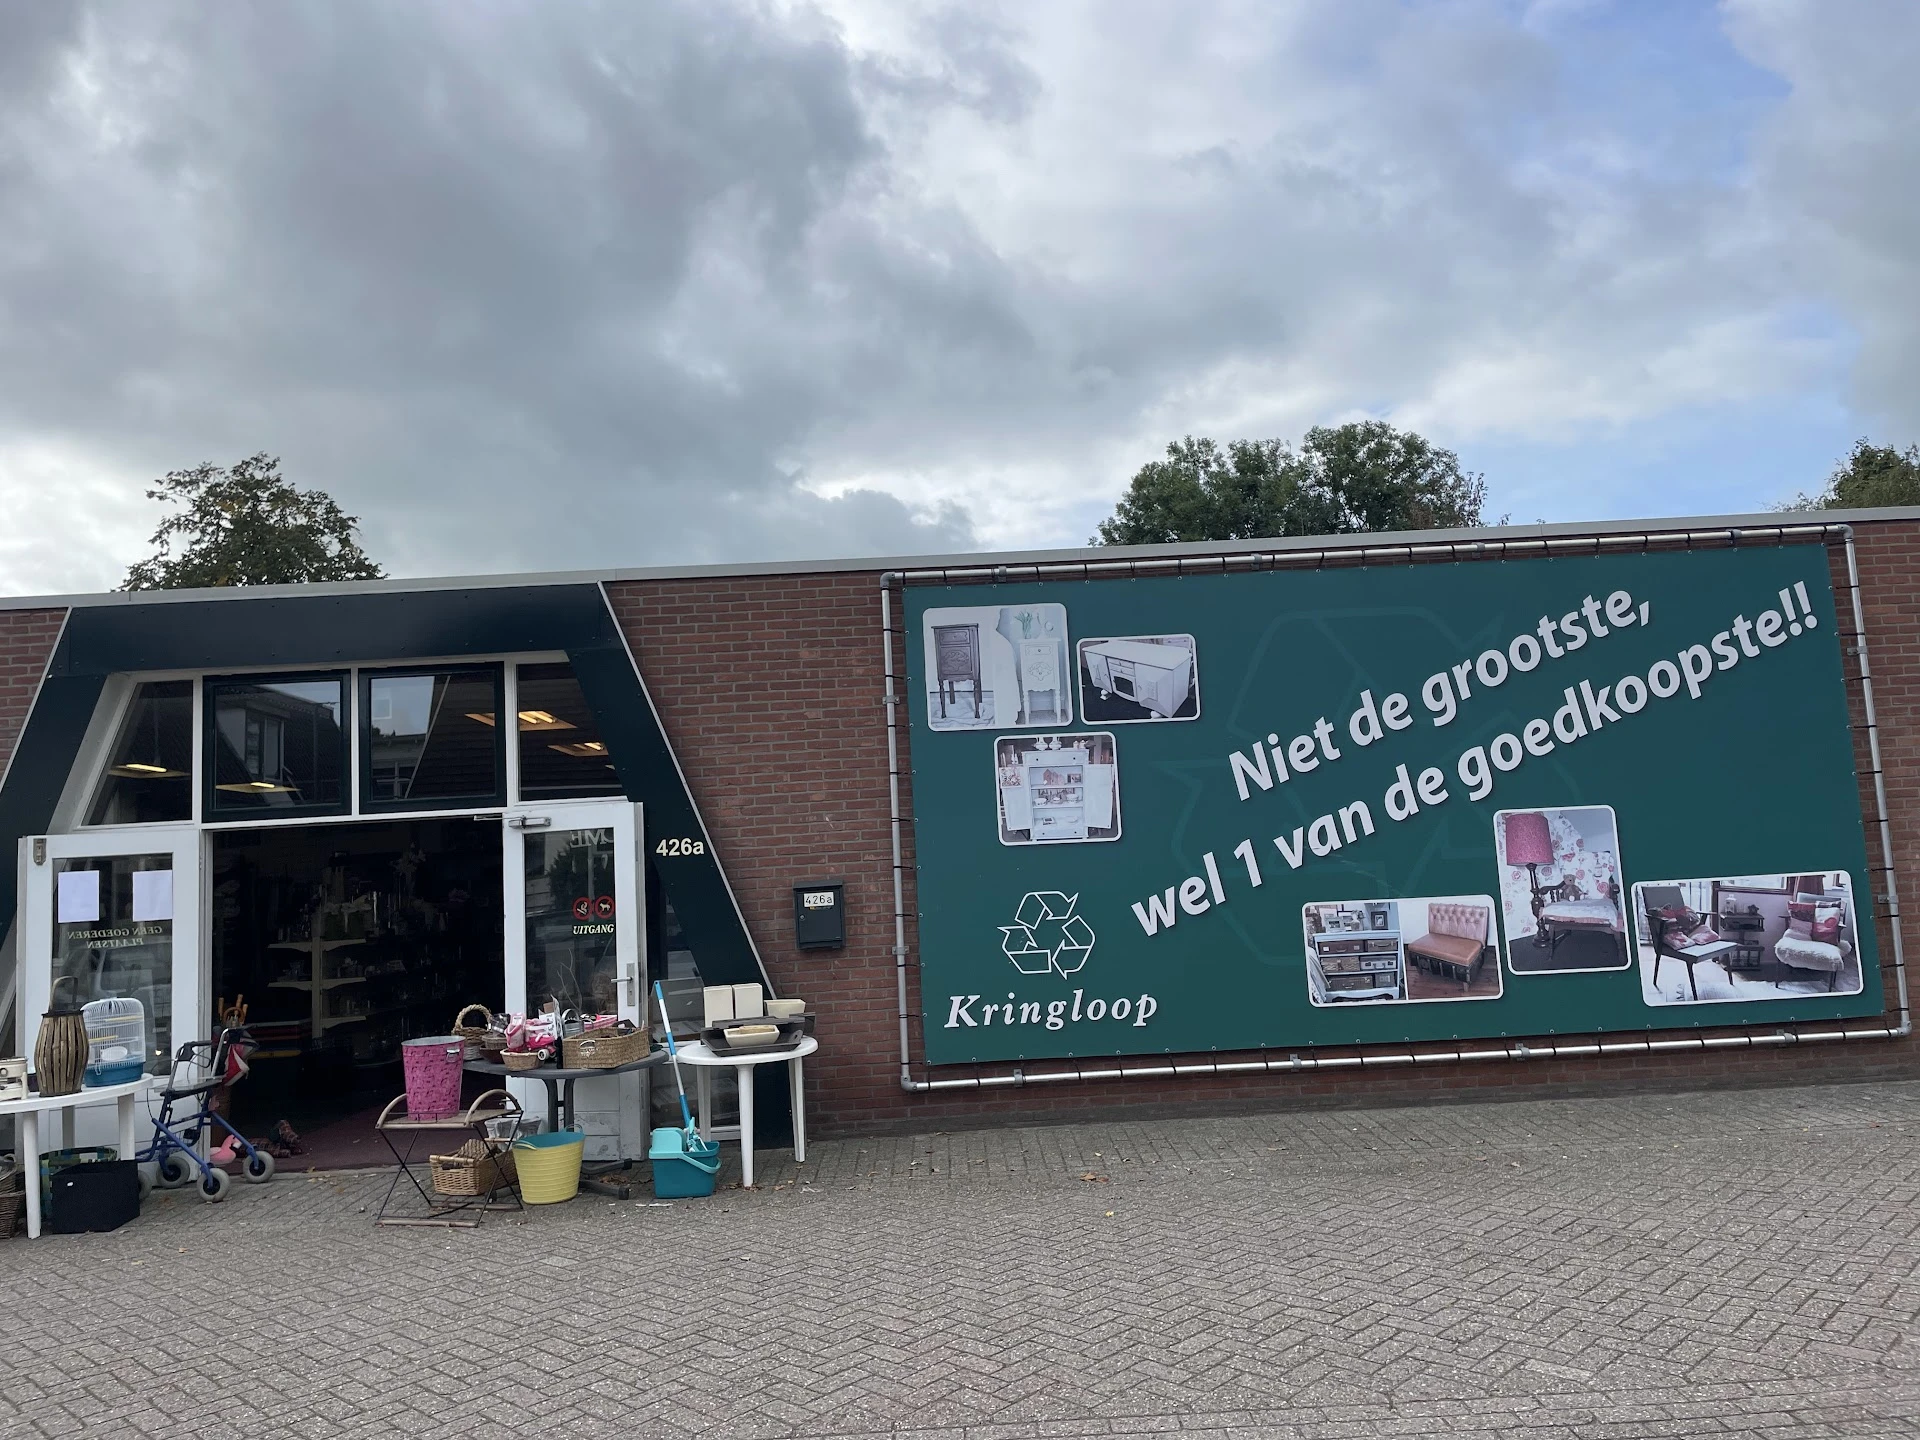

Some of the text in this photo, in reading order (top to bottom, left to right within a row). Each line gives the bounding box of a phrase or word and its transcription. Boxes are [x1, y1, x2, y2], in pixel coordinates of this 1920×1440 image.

[1228, 590, 1650, 801] Niet de grootste,
[1130, 580, 1818, 937] wel 1 van de goedkoopste!!
[656, 837, 705, 857] 426a
[805, 895, 833, 905] 426a
[572, 923, 615, 935] UITGANG
[943, 988, 1158, 1031] Kringloop
